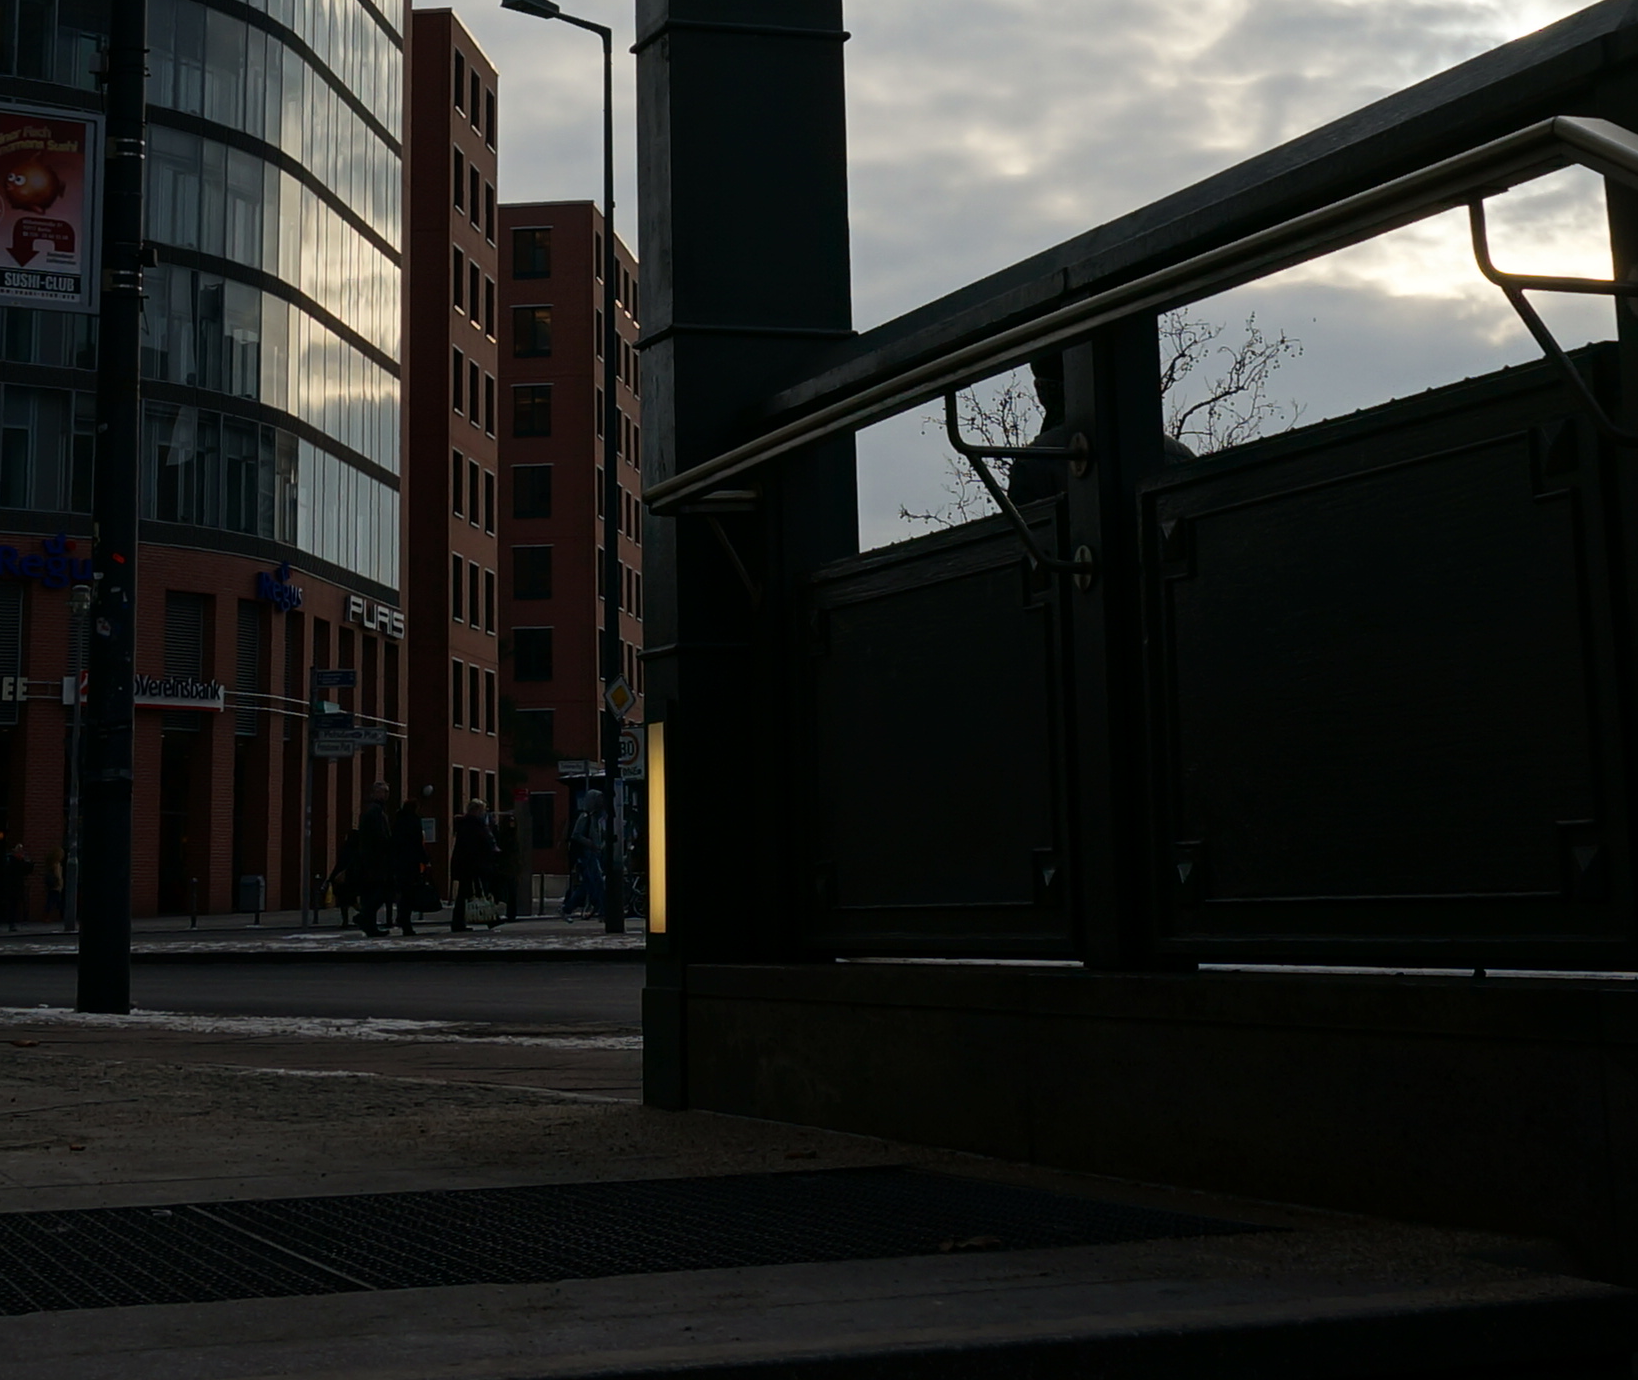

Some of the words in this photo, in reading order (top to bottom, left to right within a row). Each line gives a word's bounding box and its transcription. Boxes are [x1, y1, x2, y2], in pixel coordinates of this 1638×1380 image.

[4, 271, 75, 292] SUSHI-CLUB
[257, 571, 304, 613] Regus
[134, 674, 221, 701] Vereinsbank
